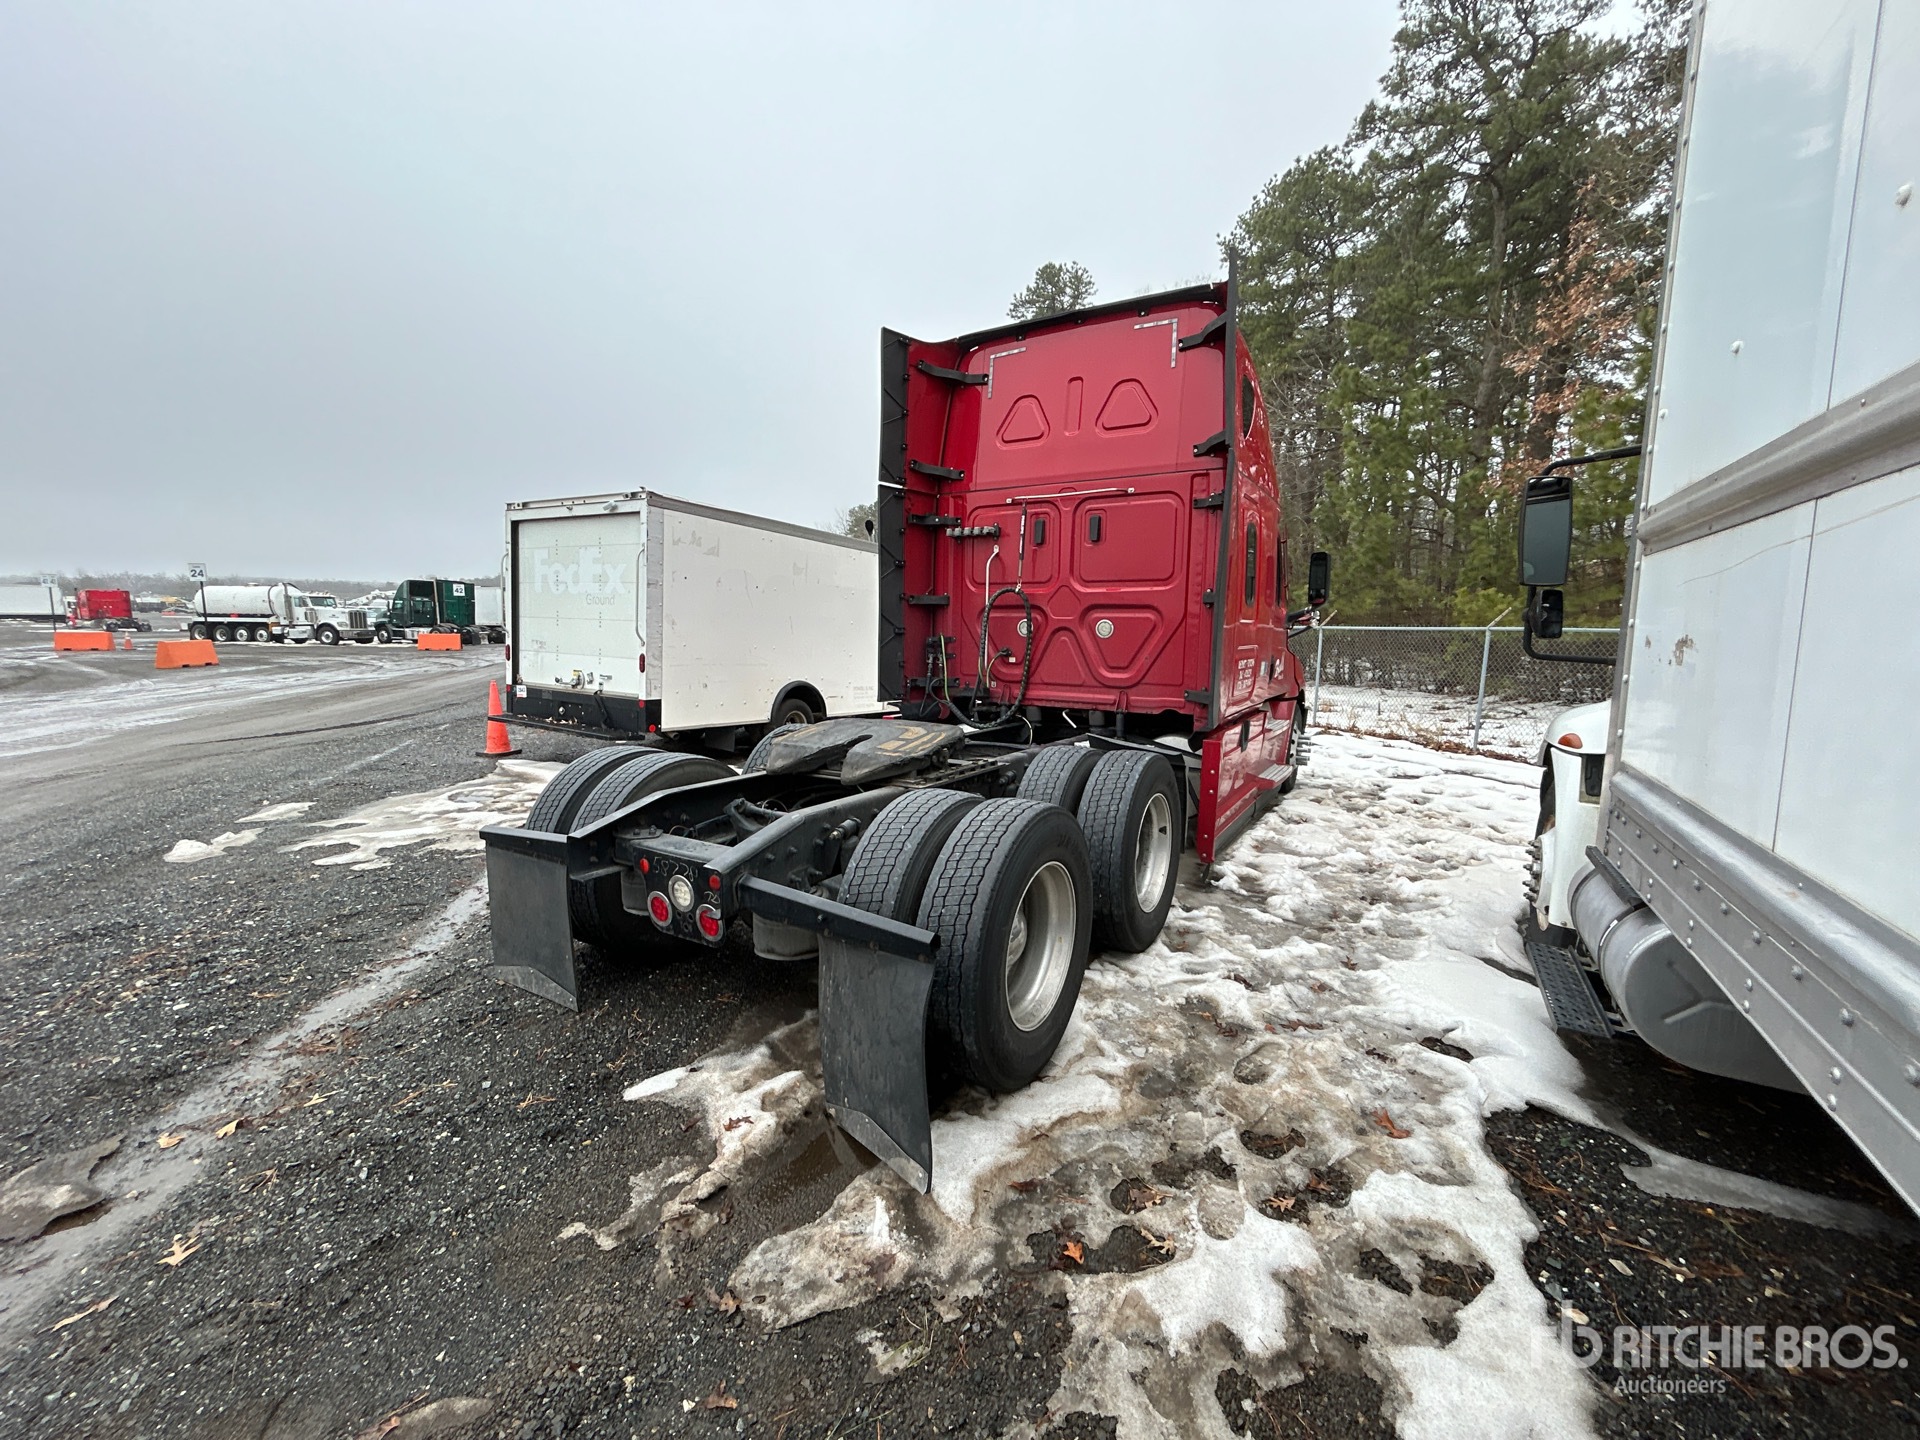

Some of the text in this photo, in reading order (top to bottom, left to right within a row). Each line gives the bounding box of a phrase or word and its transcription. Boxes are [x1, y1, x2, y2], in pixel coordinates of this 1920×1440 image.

[190, 569, 204, 577] 24
[534, 547, 627, 594] FedEx
[586, 593, 615, 605] Ground
